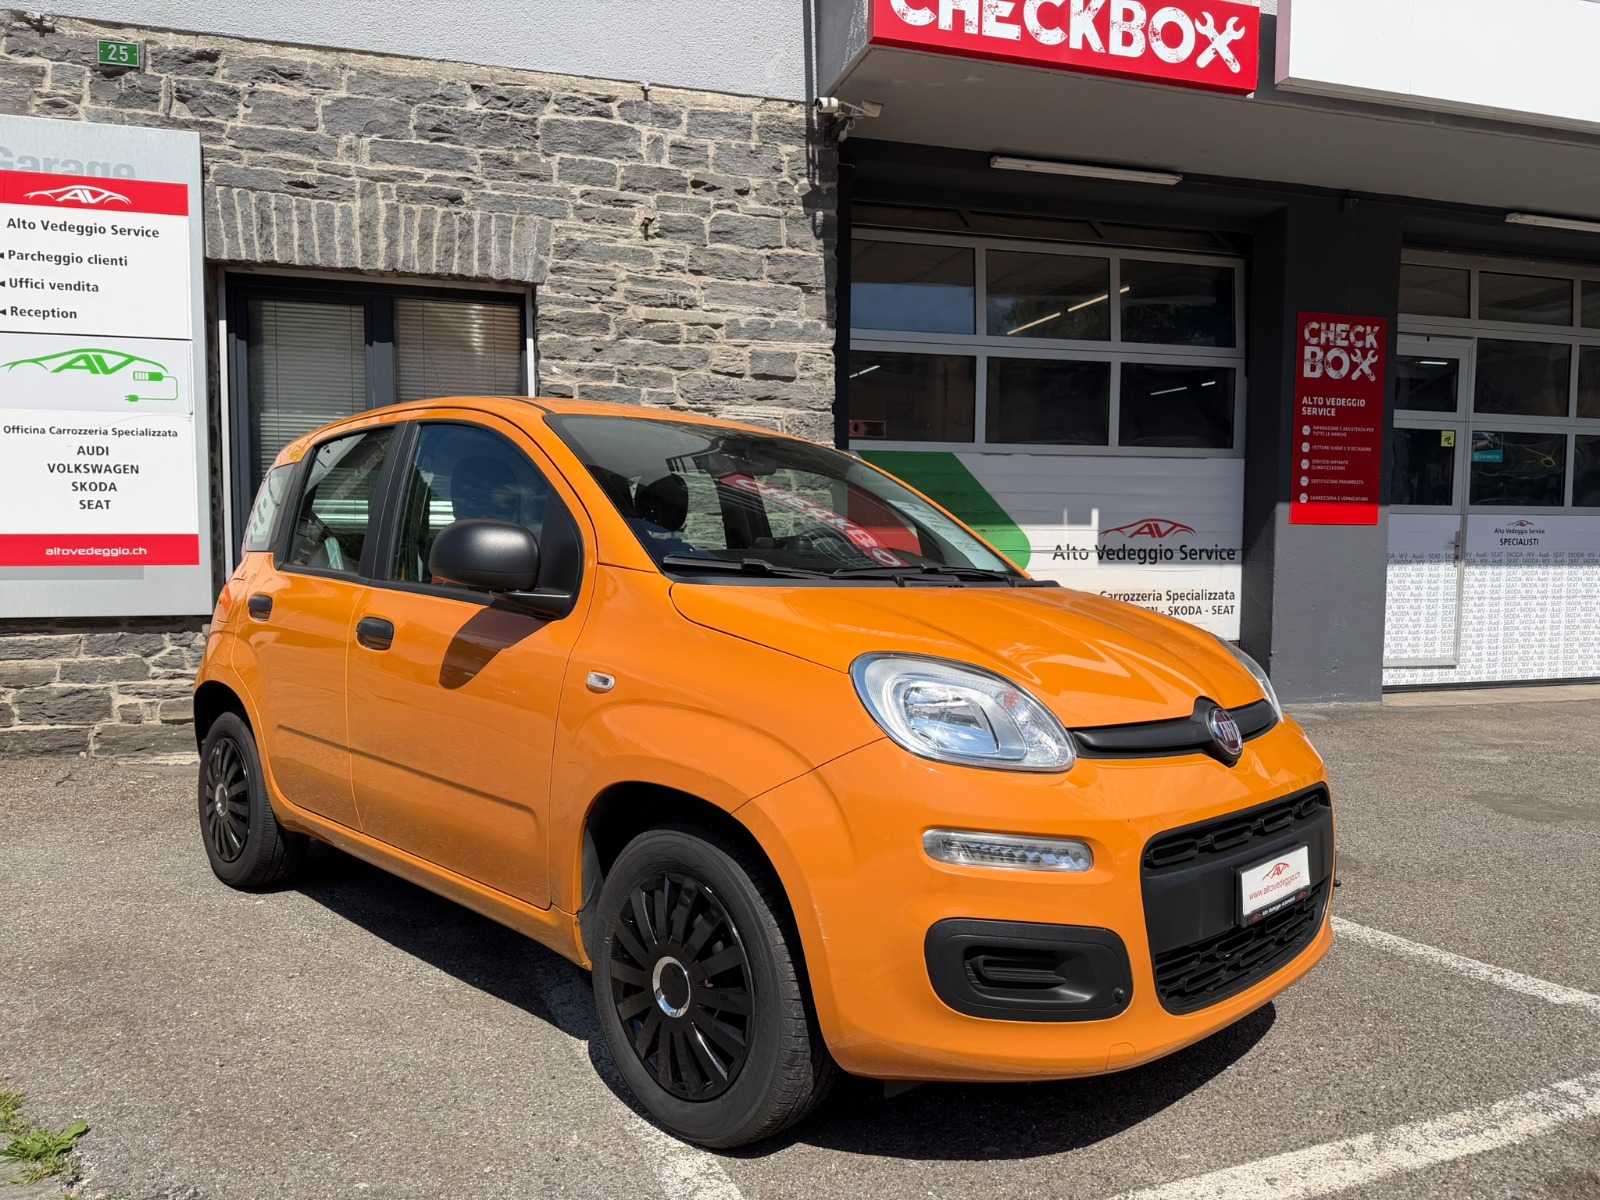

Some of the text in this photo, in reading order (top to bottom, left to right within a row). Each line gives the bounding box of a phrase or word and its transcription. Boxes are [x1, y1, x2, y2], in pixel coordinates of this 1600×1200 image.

[108, 44, 128, 62] 25
[6, 218, 160, 238] Alto Vedeggio Service
[8, 250, 128, 266] Parcheggio clienti
[9, 278, 99, 292] Uffici vendita
[10, 306, 78, 320] Reception
[1304, 322, 1380, 348] CHECK
[1303, 346, 1378, 382] BOX
[1302, 396, 1366, 407] ALTO VEDEGGIO
[1302, 407, 1336, 416] SERVICE
[4, 425, 178, 438] Officina Carrozzeria Specializzata
[76, 446, 110, 456] AUDI
[47, 464, 140, 474] VOLKSWAGEN
[71, 482, 118, 492] SKODA
[79, 500, 112, 510] SEAT
[45, 547, 148, 557] altovedeggio.ch
[1052, 544, 1235, 565] Alto Vedeggio Service
[1166, 589, 1235, 604] Specializzata
[1168, 606, 1202, 616] SKODA
[1211, 605, 1235, 615] SEAT
